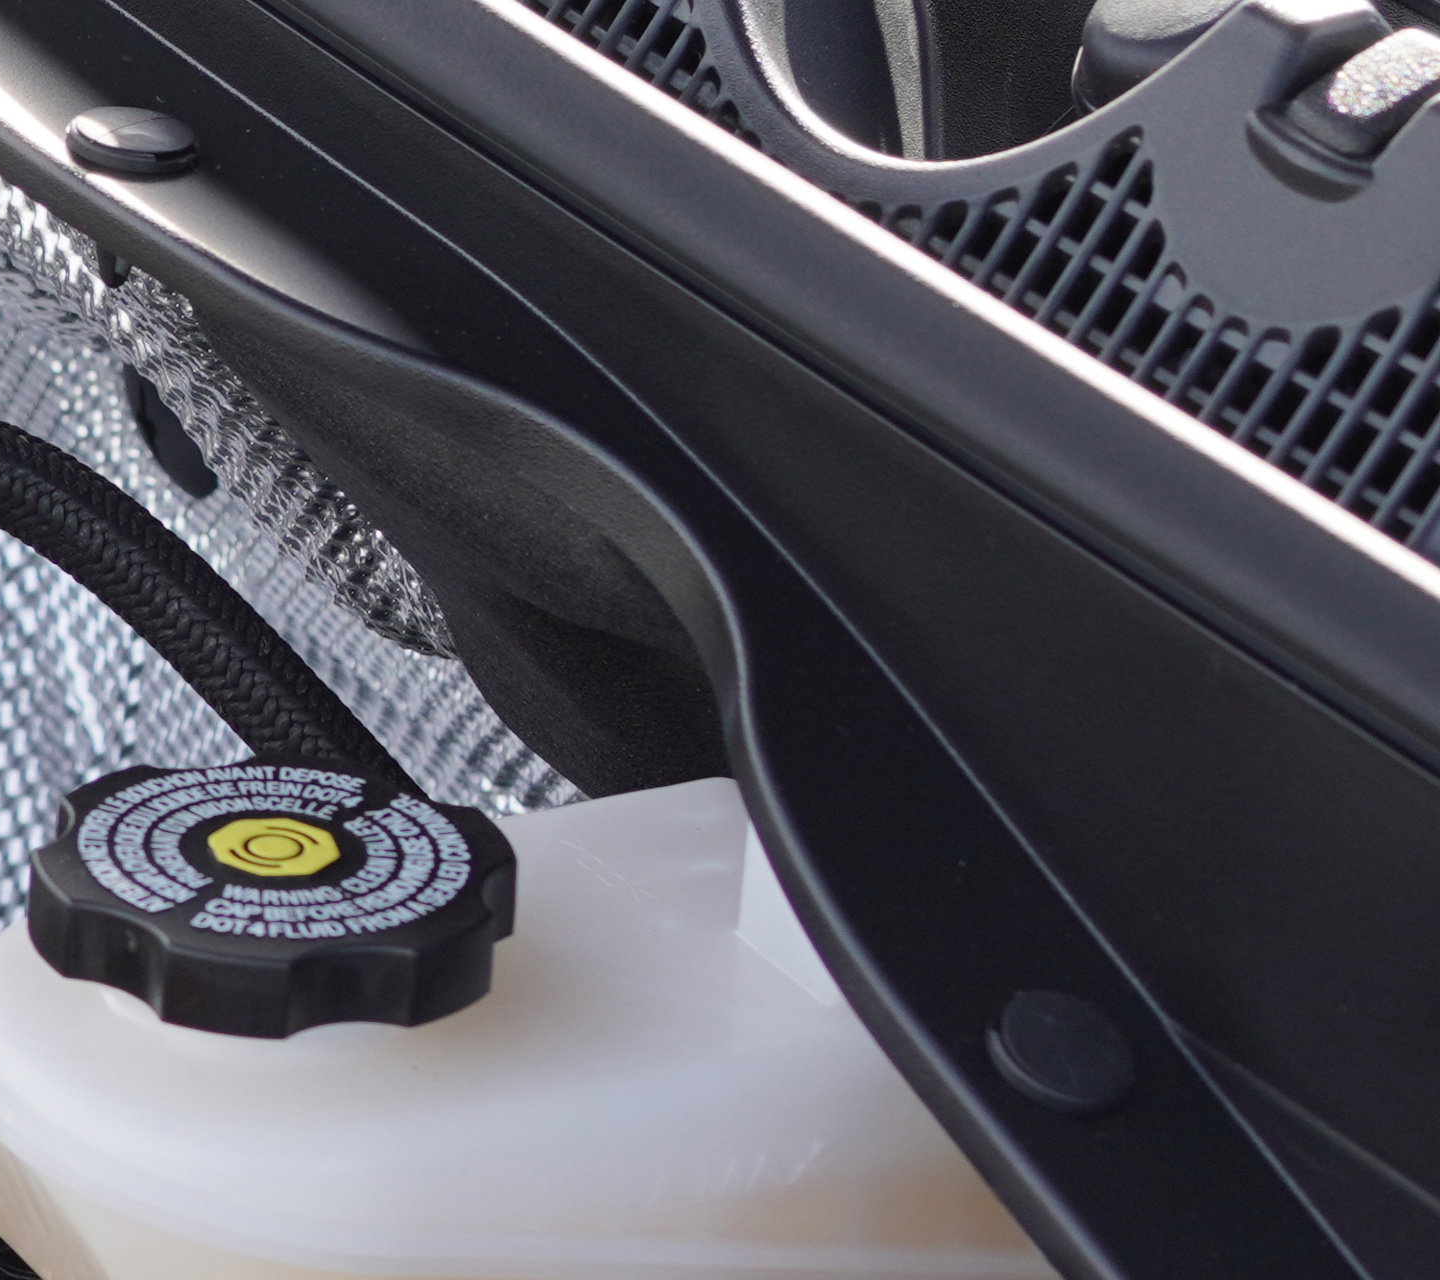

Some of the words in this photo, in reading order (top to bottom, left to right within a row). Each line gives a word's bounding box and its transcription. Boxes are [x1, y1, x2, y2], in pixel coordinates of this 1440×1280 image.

[205, 766, 275, 782] AVANT
[238, 781, 302, 797] FREIN
[205, 898, 264, 919] CAP
[268, 920, 346, 939] FLUID
